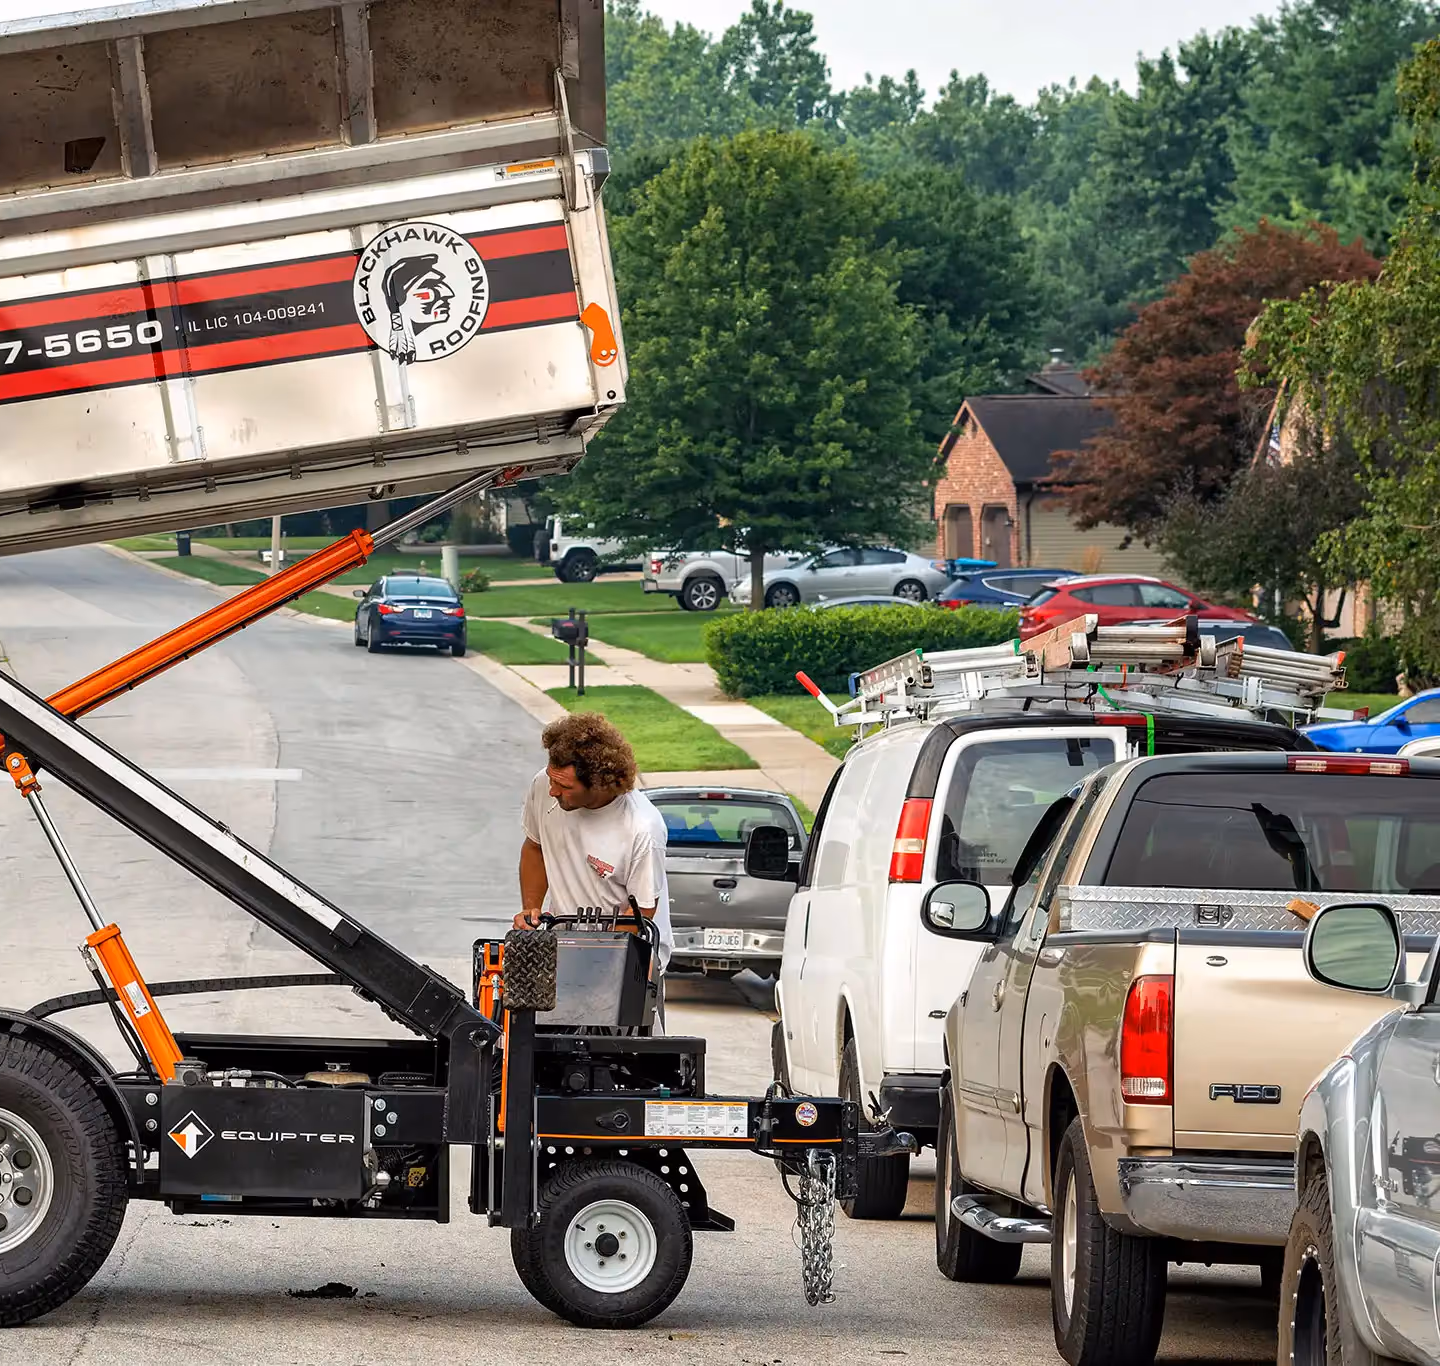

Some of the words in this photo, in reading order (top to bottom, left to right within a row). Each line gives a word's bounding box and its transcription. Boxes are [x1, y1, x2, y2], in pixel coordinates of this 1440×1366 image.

[358, 228, 464, 325] BLACKHAWK
[429, 257, 485, 354] ROOFING
[188, 320, 201, 333] IL
[205, 316, 228, 330] LIC
[233, 302, 325, 326] 104-009241
[220, 1130, 356, 1144] EQUIPTER
